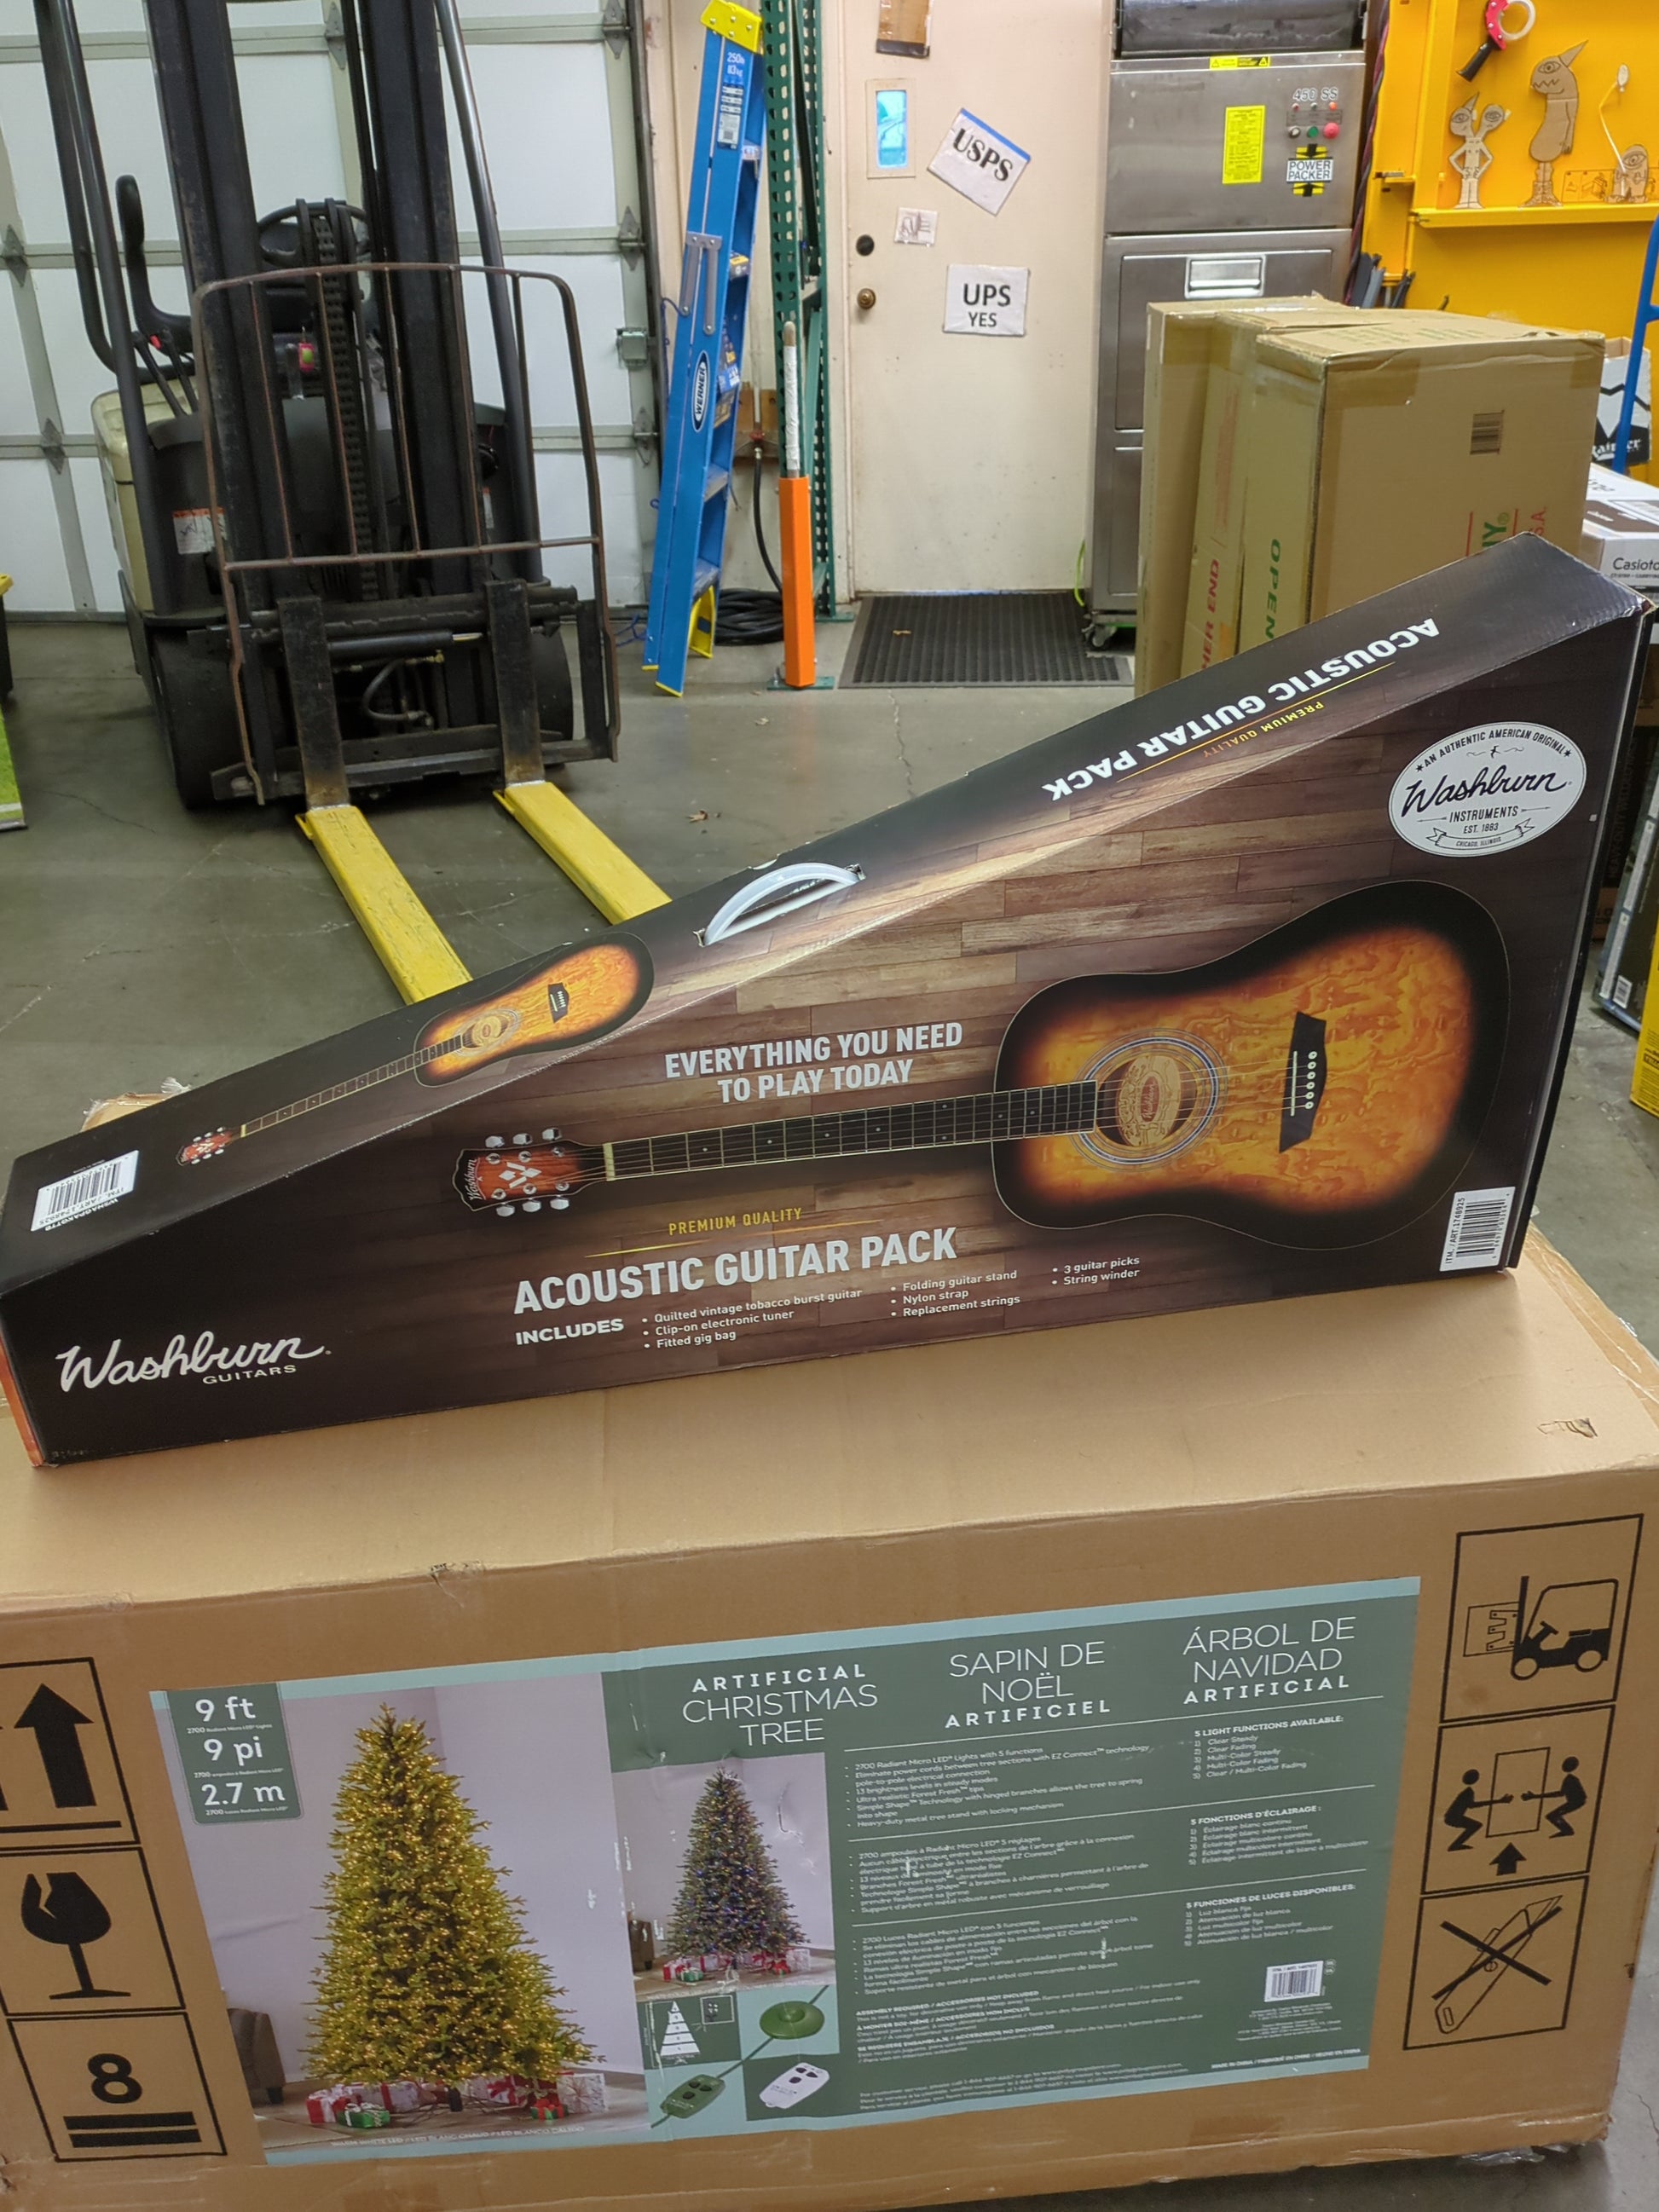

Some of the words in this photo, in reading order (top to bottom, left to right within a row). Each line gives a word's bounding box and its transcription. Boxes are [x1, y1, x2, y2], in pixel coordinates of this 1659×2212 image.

[1292, 88, 1317, 101] 450
[1321, 87, 1338, 101] SS
[953, 128, 1014, 182] USPS
[1289, 160, 1331, 170] POWER
[1288, 170, 1330, 180] PACKER
[963, 283, 1011, 307] UPS
[968, 312, 997, 327] YES
[695, 367, 706, 415] WERNER
[1207, 559, 1219, 613] END
[1265, 538, 1280, 639] OPEN
[1268, 618, 1441, 702] ACOUSTIC
[1136, 695, 1266, 758] GUITAR
[1261, 702, 1325, 734] PREMIUM
[1203, 729, 1258, 759] QUALITY
[1424, 754, 1437, 767] AN
[1439, 732, 1486, 758] AUTHENTIC
[1488, 729, 1532, 739] AMERICAN
[1533, 732, 1566, 754] ORIGINAL
[1041, 757, 1137, 801] PACK
[1401, 765, 1568, 817] Washburn
[1449, 806, 1518, 823] INSTRUMENTS
[1464, 824, 1478, 834] EST.
[664, 1037, 831, 1079] EVERYTHING
[837, 1030, 888, 1059] YOU
[895, 1022, 962, 1053] NEED
[717, 1077, 750, 1103] TO
[758, 1069, 824, 1099] PLAY
[830, 1059, 914, 1090] TODAY
[668, 1215, 737, 1236] PREMIUM
[742, 1207, 802, 1227] QUALITY
[513, 1256, 704, 1314] ACOUSTIC
[714, 1239, 850, 1286] GUITAR
[859, 1227, 957, 1269] PACK
[1063, 1274, 1098, 1287] String
[1101, 1268, 1140, 1280] winder
[1064, 1265, 1072, 1273] 3
[1073, 1260, 1107, 1274] guitar
[1110, 1256, 1140, 1270] picks
[903, 1279, 946, 1292] Folding
[948, 1274, 982, 1288] guitar
[985, 1270, 1017, 1282] stand
[654, 1308, 697, 1323] Quilted
[699, 1303, 743, 1318] vintage
[745, 1297, 791, 1311] tobacco
[794, 1291, 825, 1305] burst
[827, 1289, 863, 1303] guitar
[903, 1291, 936, 1305] Nylon
[939, 1288, 969, 1302] strap
[903, 1300, 978, 1317] Replacement
[980, 1295, 1020, 1309] strings
[515, 1318, 624, 1346] INCLUDES
[656, 1322, 699, 1337] Clip-on
[701, 1314, 760, 1330] electronic
[762, 1310, 795, 1321] tuner
[656, 1336, 691, 1349] Fitted
[694, 1333, 712, 1347] gig
[714, 1330, 737, 1343] bag
[55, 1330, 326, 1392] Washburn
[202, 1365, 298, 1384] GUITARS
[1182, 1624, 1300, 1656] ÁRBOL
[1310, 1616, 1356, 1642] DE
[949, 1646, 1049, 1678] SAPIN
[1060, 1641, 1107, 1666] DE
[1193, 1648, 1343, 1684] NAVIDAD
[691, 1664, 866, 1693] ARTIFICIAL
[982, 1672, 1074, 1705] NOËL
[1183, 1675, 1350, 1705] ARTIFICIAL
[195, 1698, 215, 1723] 9
[225, 1695, 256, 1721] ft
[682, 1684, 878, 1724] CHRISTMAS
[945, 1700, 1111, 1729] ARTIFICIEL
[739, 1718, 824, 1747] TREE
[1202, 1726, 1232, 1736] LIGHT
[1233, 1721, 1288, 1734] FUNCTIONS
[1290, 1715, 1344, 1728] AVAILABLE:
[204, 1738, 223, 1762] 9
[234, 1735, 263, 1767] pi
[201, 1782, 243, 1806] 2.7
[253, 1785, 286, 1803] m
[1198, 1813, 1253, 1824] FONCTIONS
[1194, 1897, 1247, 1909] FUNCIONES
[1262, 1891, 1292, 1901] LUCES
[1292, 1884, 1356, 1897] DISPONIBLES:
[88, 2053, 142, 2104] 8
